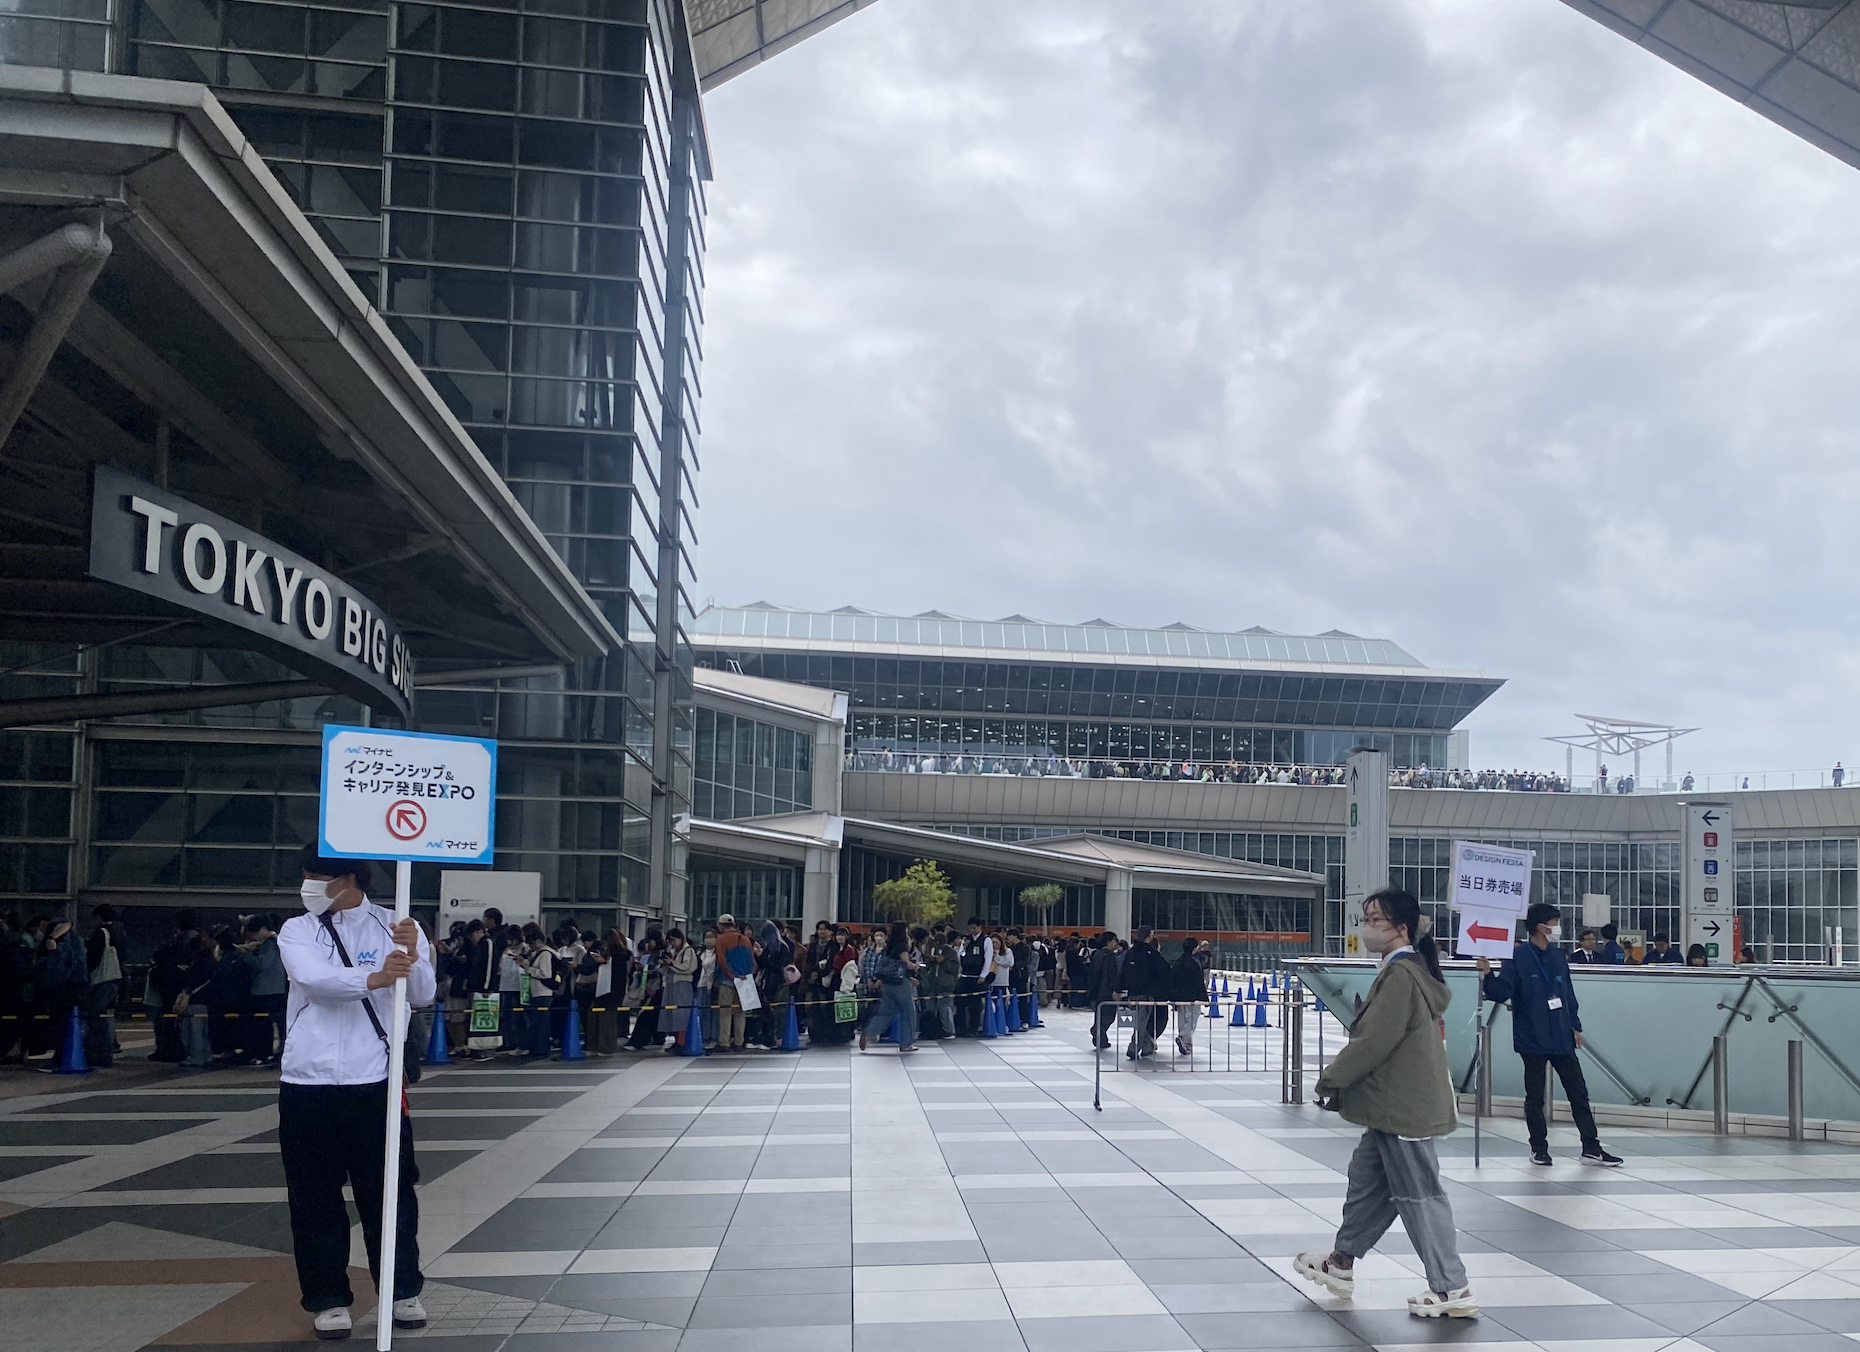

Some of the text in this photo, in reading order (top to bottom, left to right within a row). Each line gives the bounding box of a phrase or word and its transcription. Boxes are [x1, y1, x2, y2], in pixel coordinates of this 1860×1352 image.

[131, 495, 333, 641] TOKYO
[343, 596, 388, 675] BIG
[363, 746, 394, 757] マイナビ
[344, 760, 454, 781] インターンシップ&
[343, 777, 475, 800] キャリア発見EXPO
[445, 840, 478, 851] マイナビ
[1474, 854, 1501, 864] DESIGN
[1502, 858, 1524, 867] FESTA
[1460, 874, 1523, 896] 当日券売場
